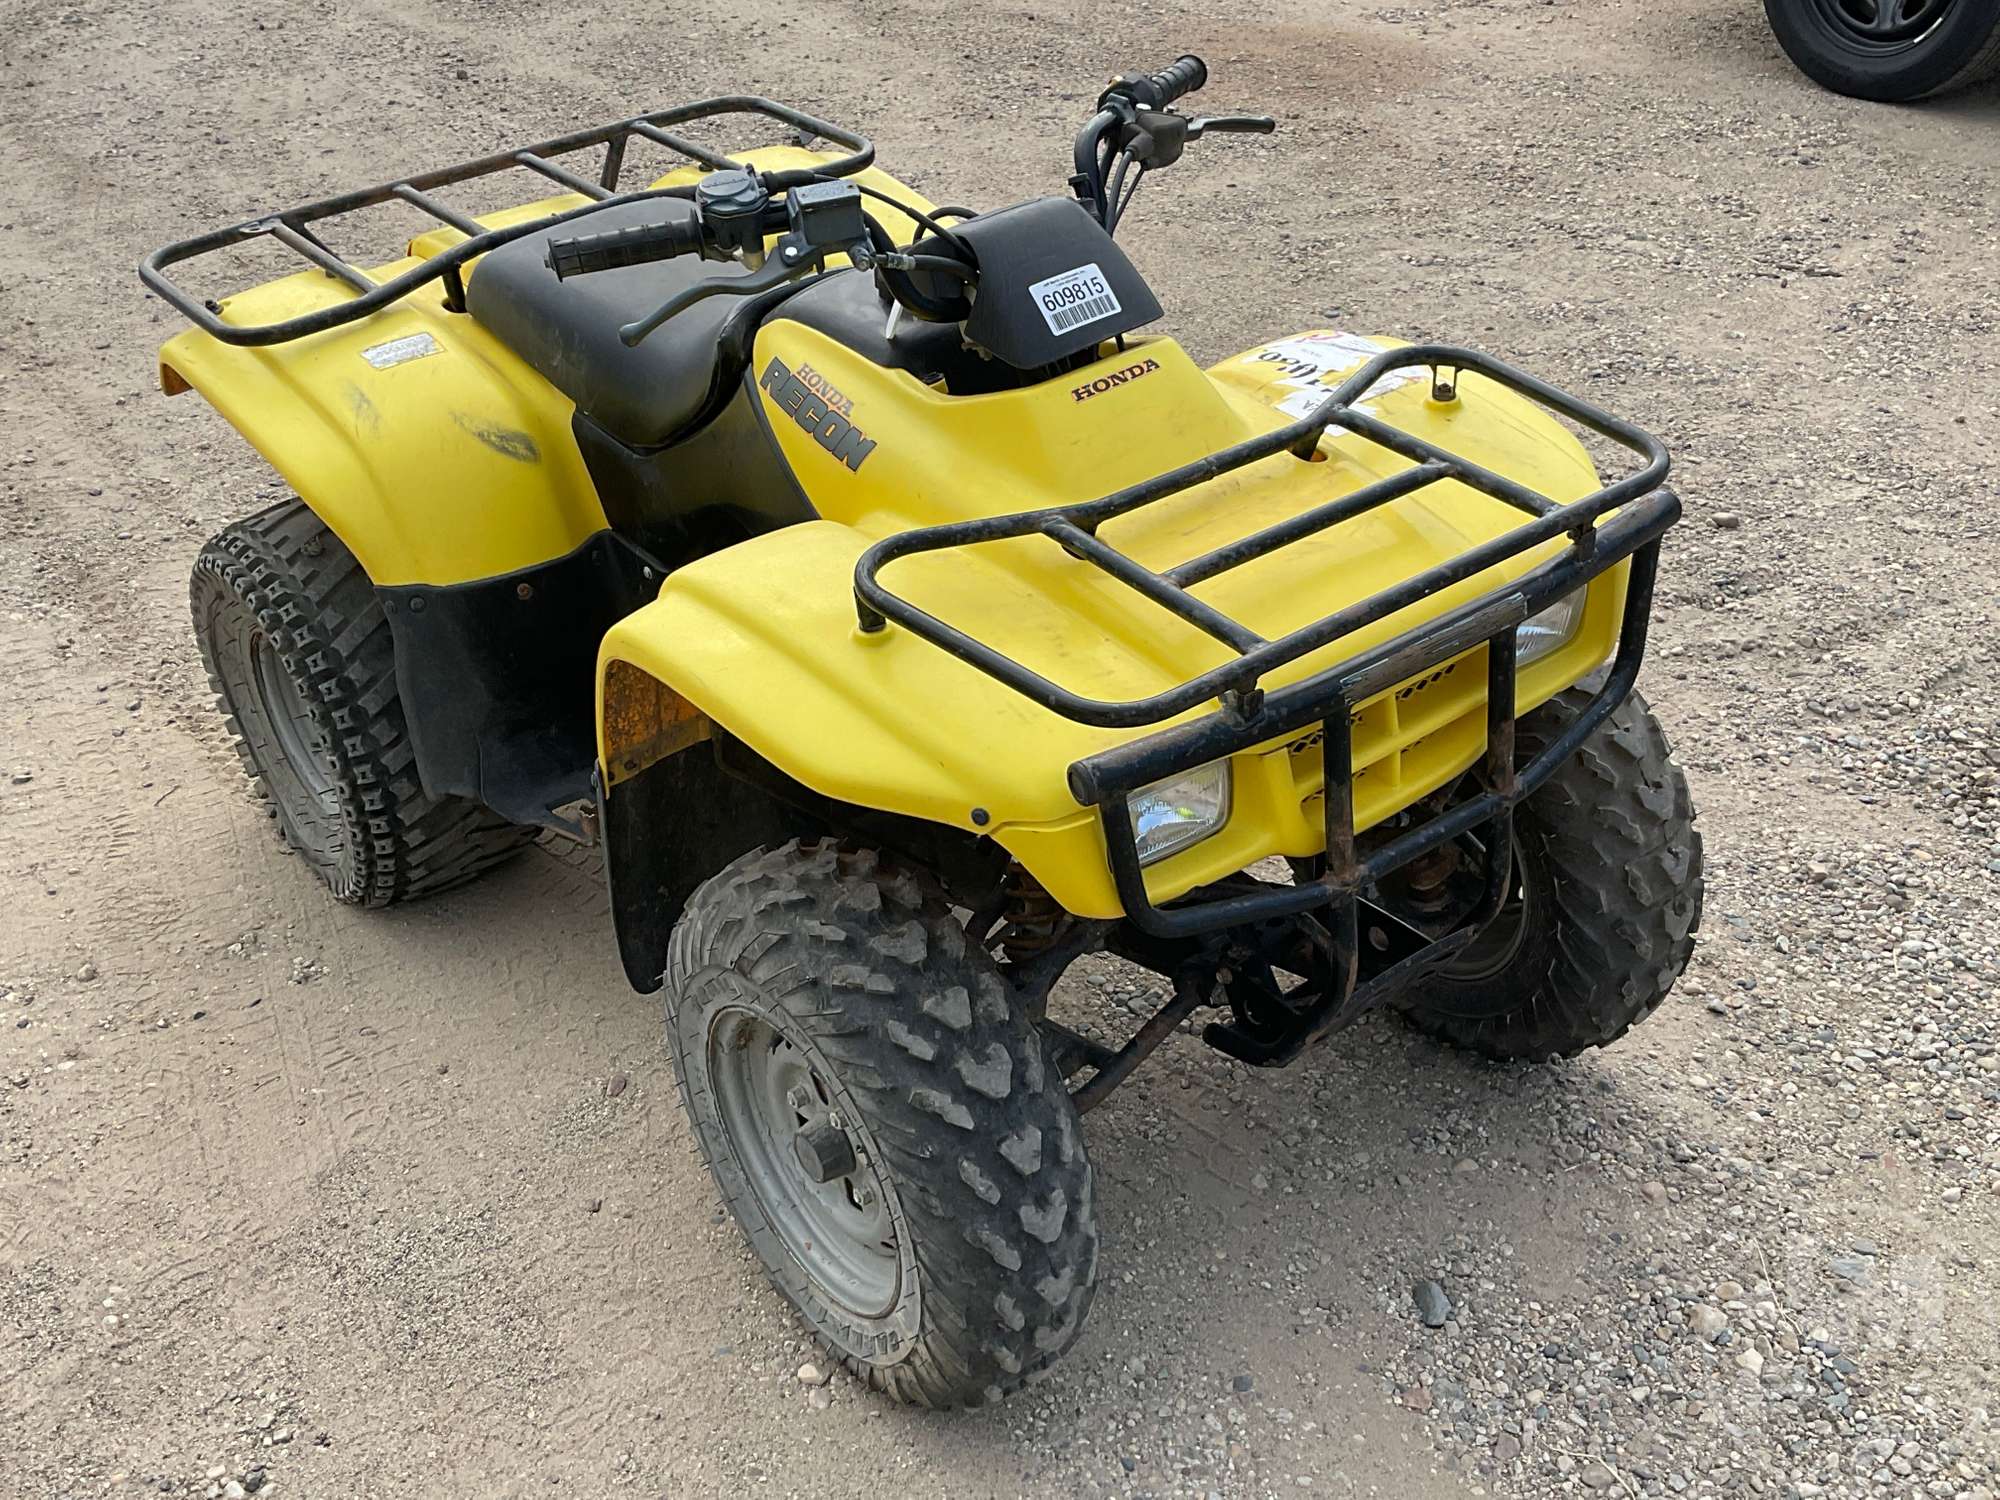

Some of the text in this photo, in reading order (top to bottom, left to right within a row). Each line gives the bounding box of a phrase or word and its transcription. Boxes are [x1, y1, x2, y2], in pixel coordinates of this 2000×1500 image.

[1042, 276, 1104, 312] 609815
[796, 362, 855, 418] HONDA
[1071, 358, 1160, 402] HONDA
[759, 356, 877, 473] RECON
